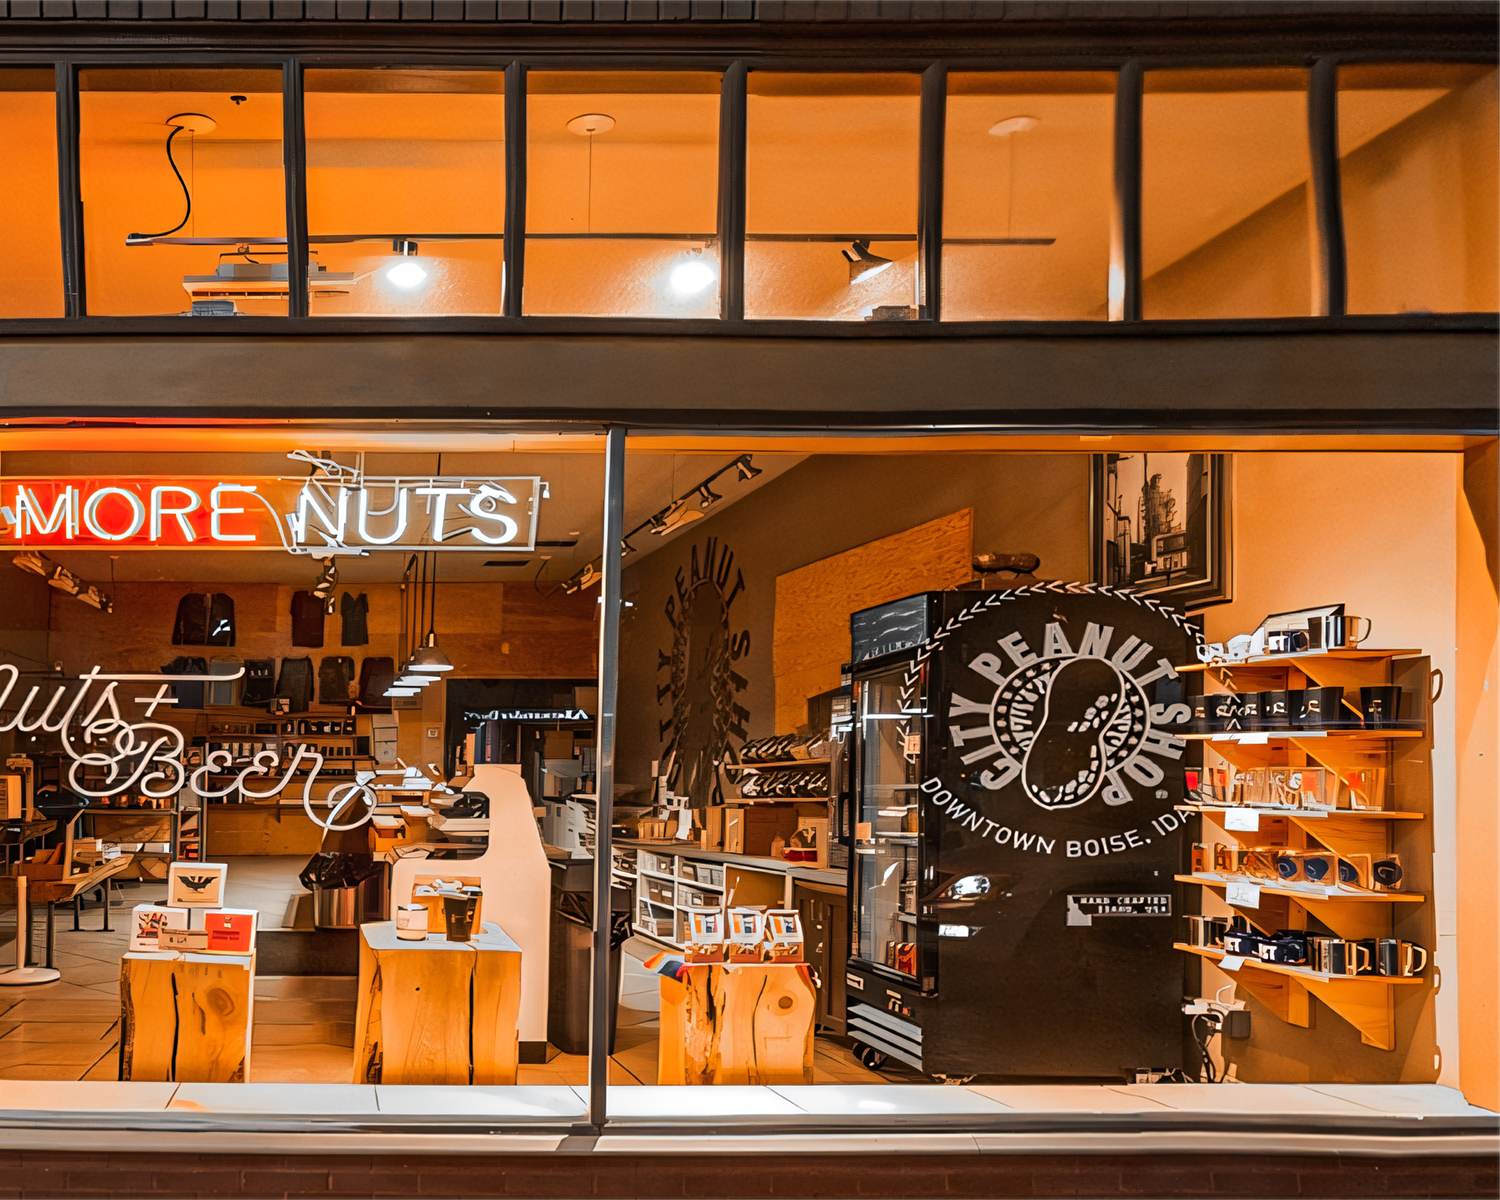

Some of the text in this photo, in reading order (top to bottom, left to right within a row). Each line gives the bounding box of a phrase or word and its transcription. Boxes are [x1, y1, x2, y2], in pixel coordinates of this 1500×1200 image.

[15, 483, 257, 542] MORE
[297, 484, 519, 545] NUTS
[948, 621, 1193, 807] CITY PEANUT SHOP
[920, 777, 1056, 855] DOWNTOWN
